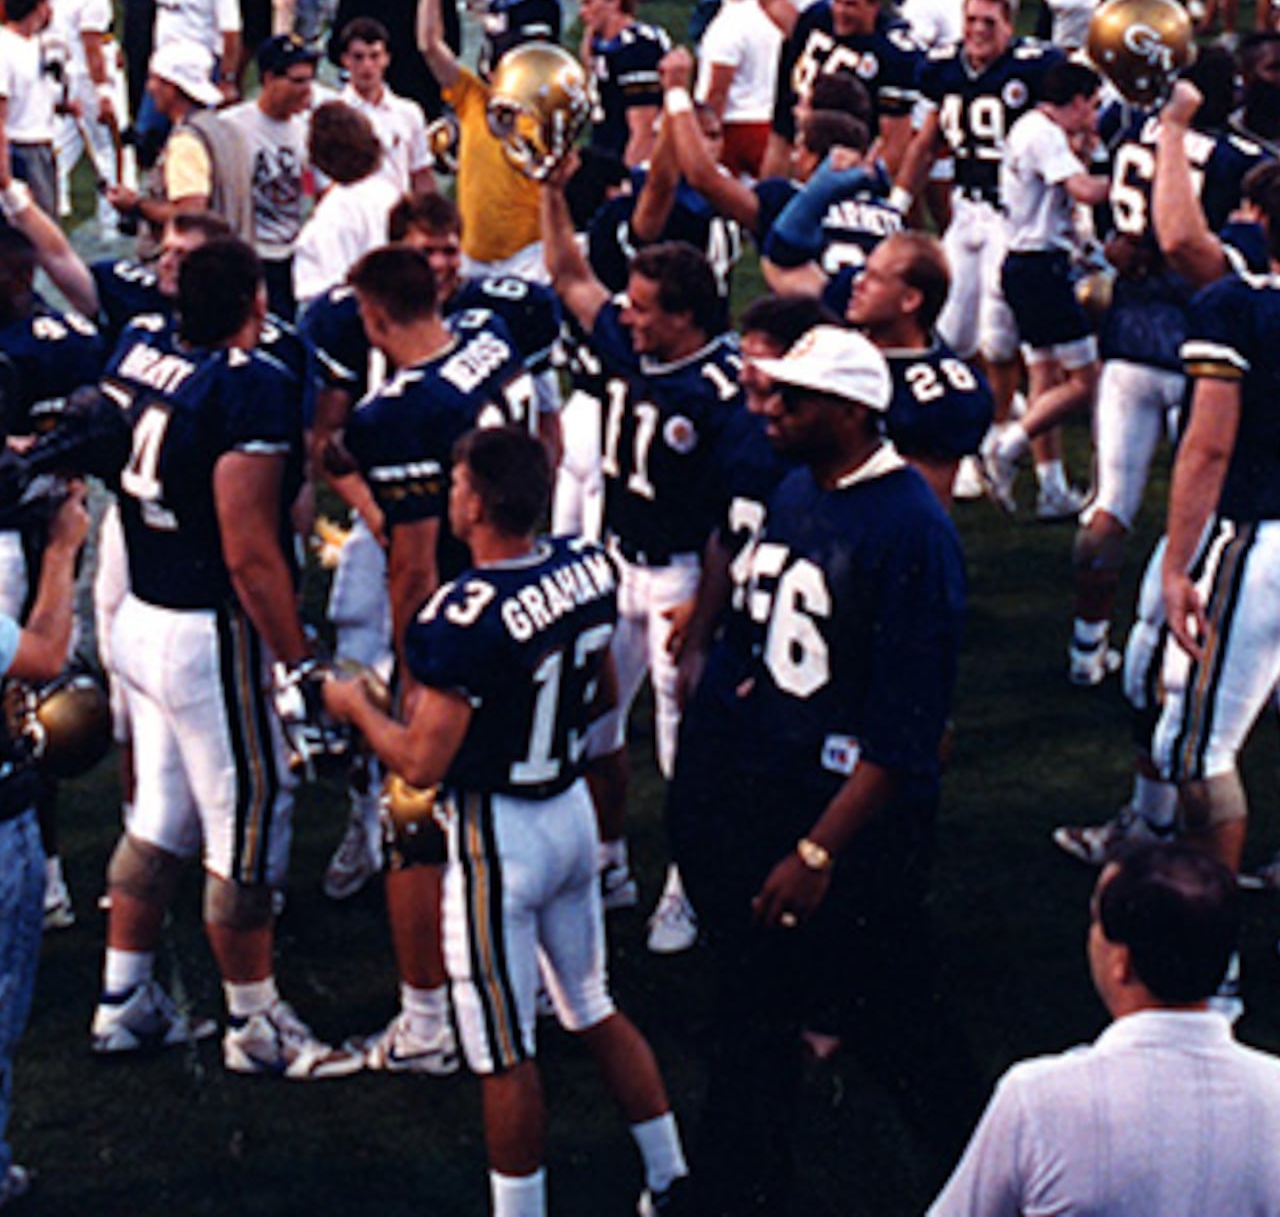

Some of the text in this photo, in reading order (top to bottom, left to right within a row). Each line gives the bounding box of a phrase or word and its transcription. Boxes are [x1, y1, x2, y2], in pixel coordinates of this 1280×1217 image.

[600, 378, 659, 501] 11
[417, 579, 498, 626] 13
[501, 549, 616, 643] GRAHAM
